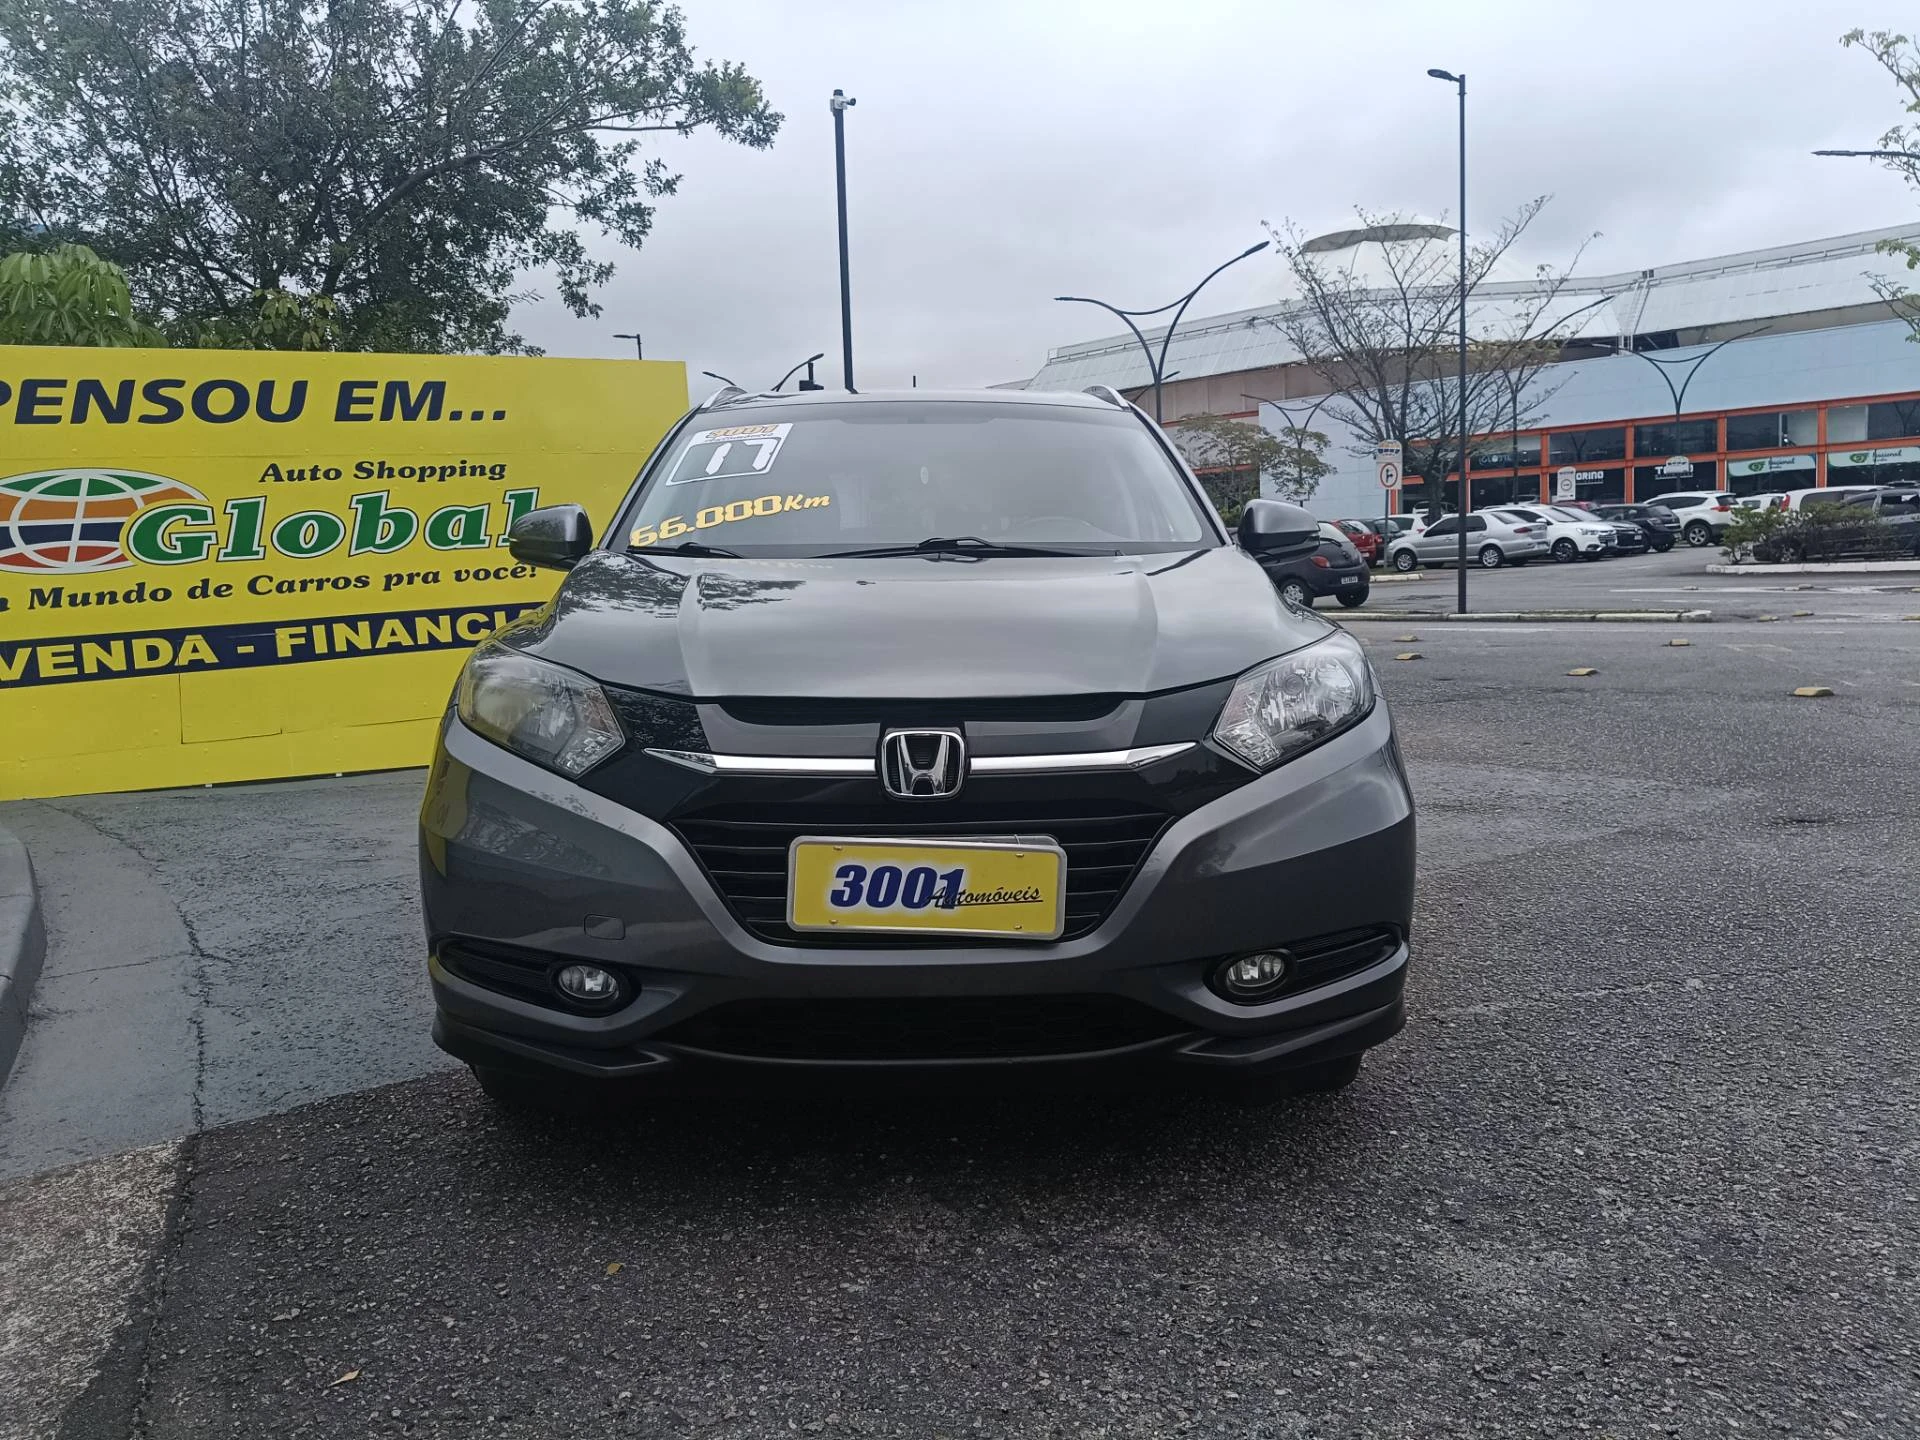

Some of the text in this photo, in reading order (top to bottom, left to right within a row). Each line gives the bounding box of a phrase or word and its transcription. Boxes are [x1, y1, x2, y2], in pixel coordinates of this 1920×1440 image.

[334, 380, 506, 422] EM...
[259, 460, 507, 482] Auto Shopping
[705, 438, 779, 475] 17
[1575, 470, 1604, 481] ORINO
[126, 487, 540, 566] Global
[28, 582, 172, 609] Mundo
[187, 578, 233, 599] de
[247, 574, 370, 596] Carros
[383, 569, 440, 592] pra
[0, 634, 219, 681] VENDA
[275, 608, 530, 658] FINANCI
[830, 864, 964, 909] 3001
